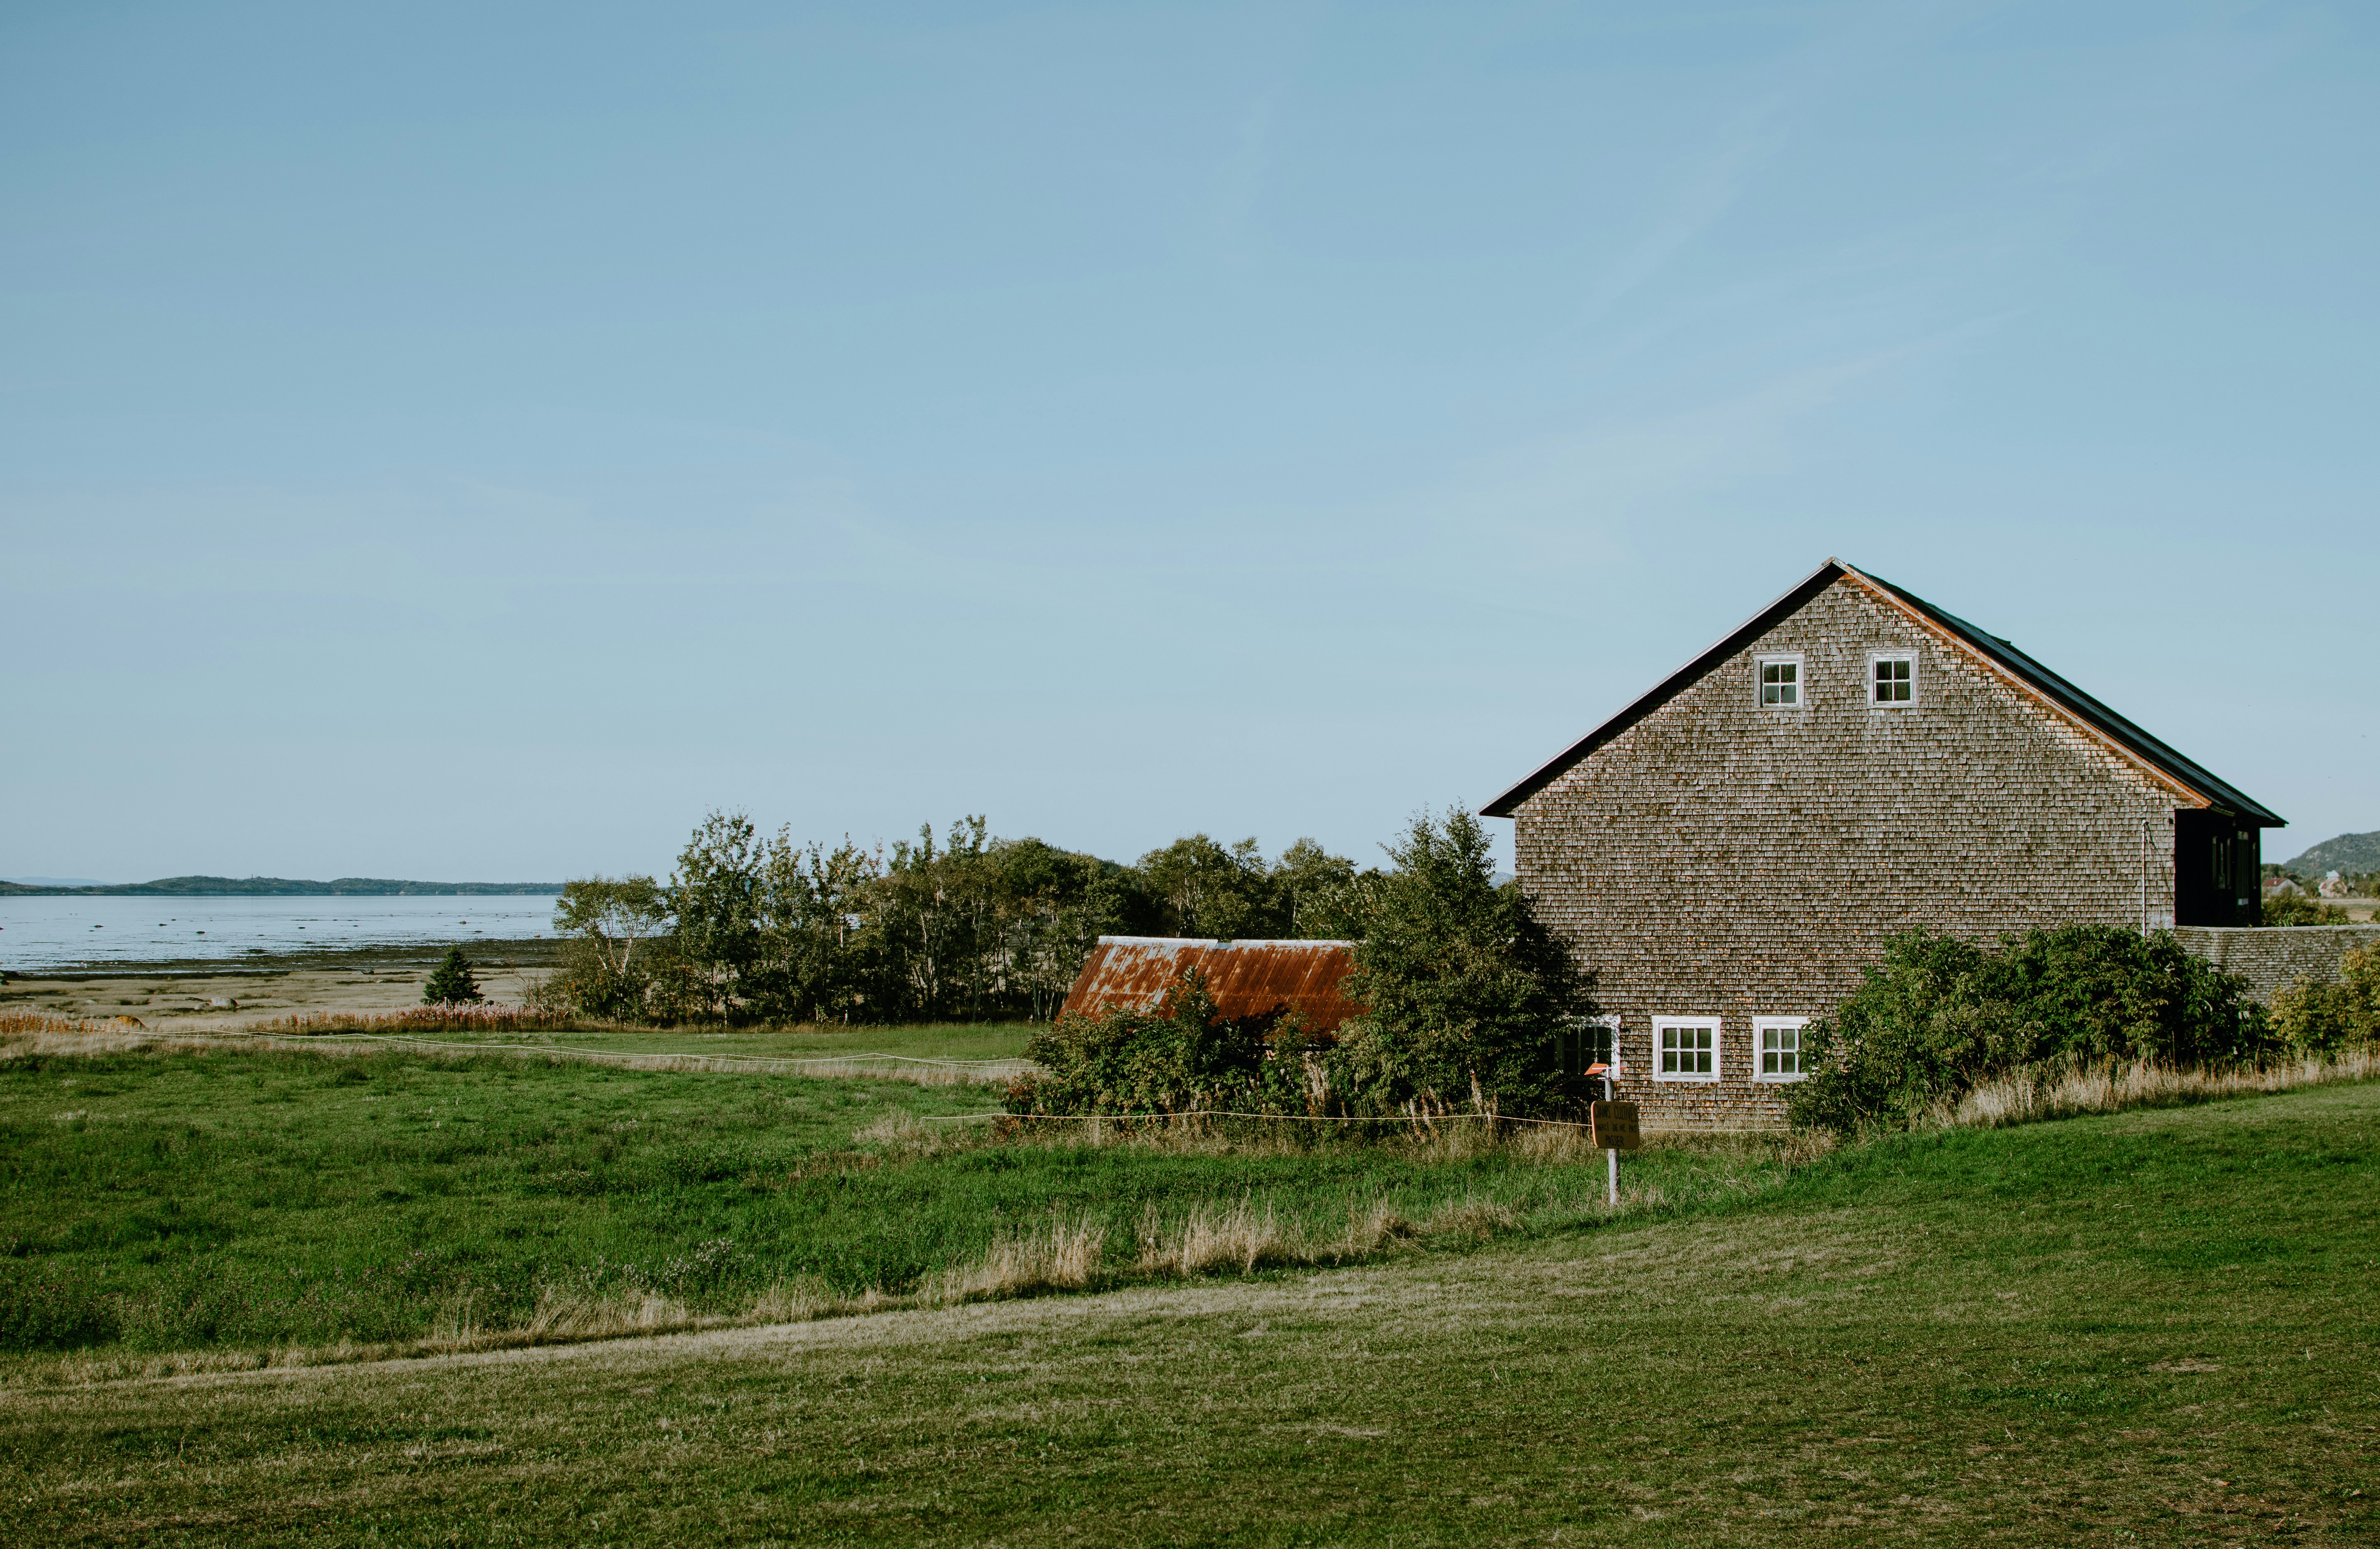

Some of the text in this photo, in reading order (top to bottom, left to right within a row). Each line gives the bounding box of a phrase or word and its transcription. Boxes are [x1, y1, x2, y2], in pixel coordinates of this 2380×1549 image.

[1594, 1104, 1611, 1118] CHAMPS
[1612, 1123, 1618, 1132] DE
[1620, 1124, 1625, 1133] NE
[1605, 1135, 1624, 1147] PASSER
